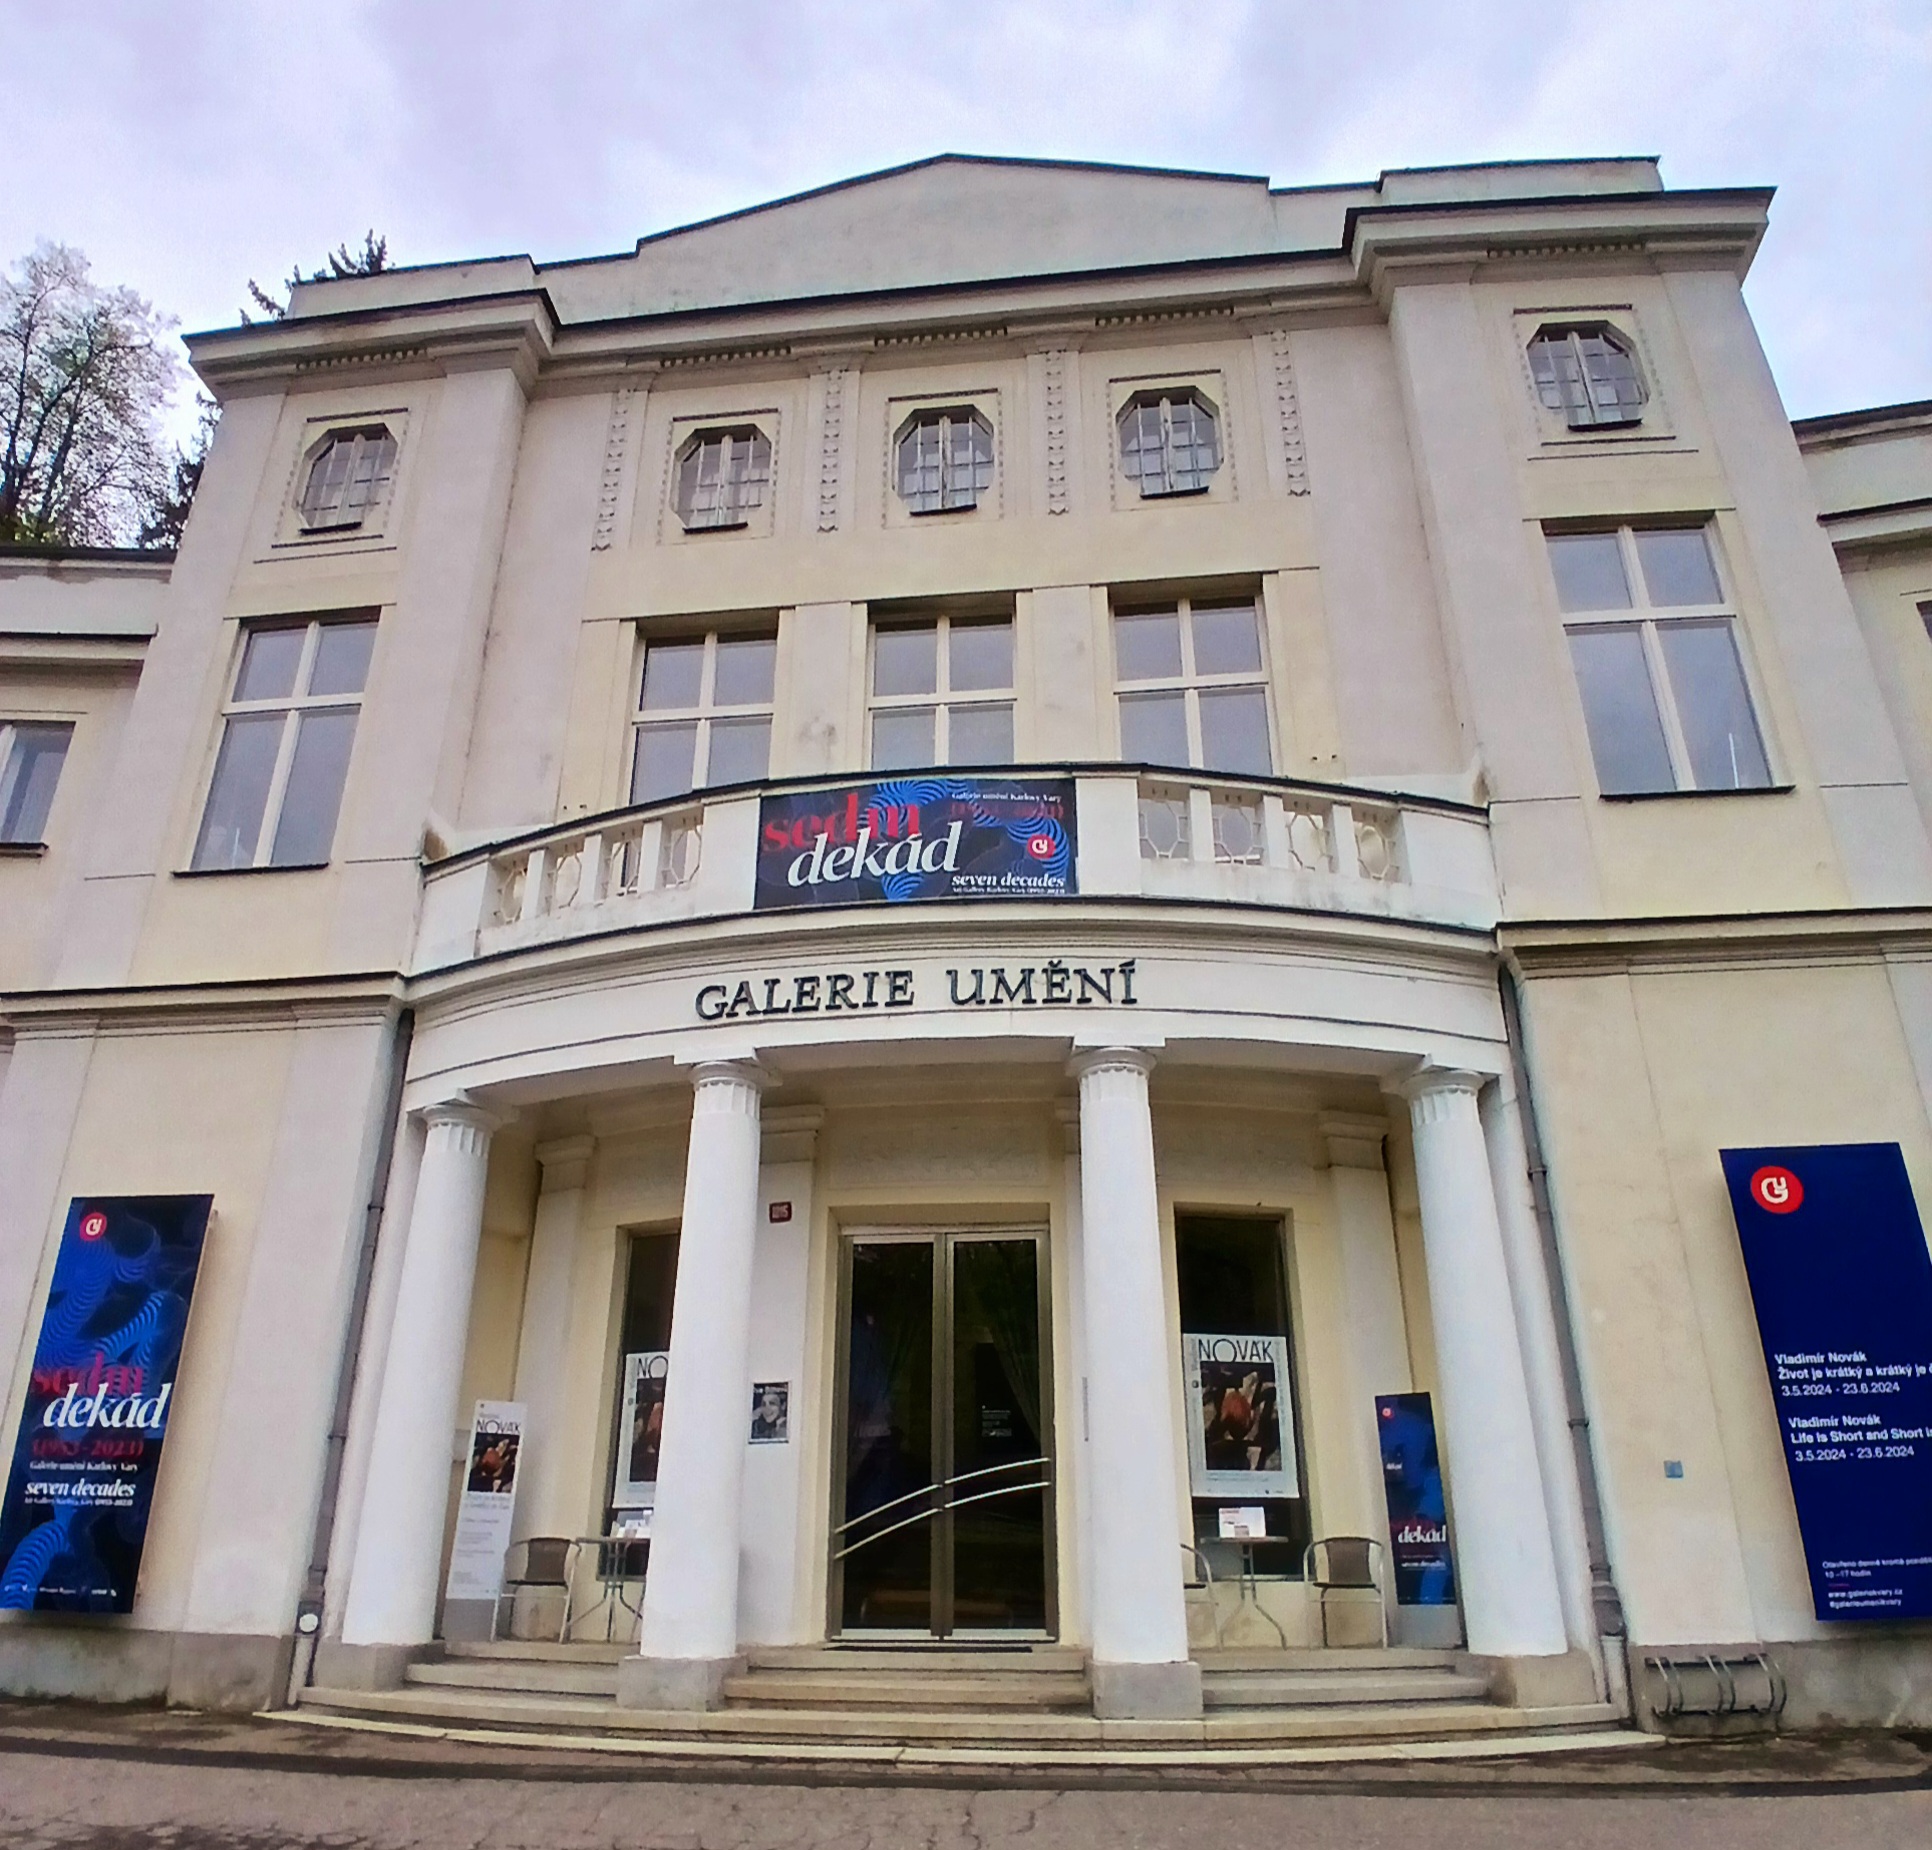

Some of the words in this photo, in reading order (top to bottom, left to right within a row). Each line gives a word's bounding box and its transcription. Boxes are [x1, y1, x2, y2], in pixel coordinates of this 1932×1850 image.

[764, 792, 920, 850] sedm
[787, 820, 964, 887] dekád
[951, 874, 997, 886] seven
[1000, 872, 1066, 887] decades
[695, 969, 915, 1021] GALERIE
[946, 958, 1139, 1007] UMĚNÍ
[1774, 1352, 1825, 1364] Vladimír
[1827, 1350, 1868, 1363] Novák
[1777, 1366, 1809, 1380] Život
[1865, 1367, 1874, 1377] a
[1781, 1384, 1833, 1397] 3.5.2024
[43, 1382, 173, 1429] dekád
[1788, 1414, 1840, 1428] Vladimír
[1842, 1413, 1882, 1426] Novák
[1790, 1431, 1814, 1444] Life
[1816, 1431, 1829, 1443] is
[1830, 1430, 1864, 1443] Short
[1866, 1428, 1889, 1441] and
[1890, 1427, 1924, 1440] Short
[1795, 1448, 1847, 1462] 3.5.2024
[1856, 1445, 1915, 1459] 23.6.2024
[25, 1482, 69, 1496] seven
[71, 1478, 137, 1497] decades
